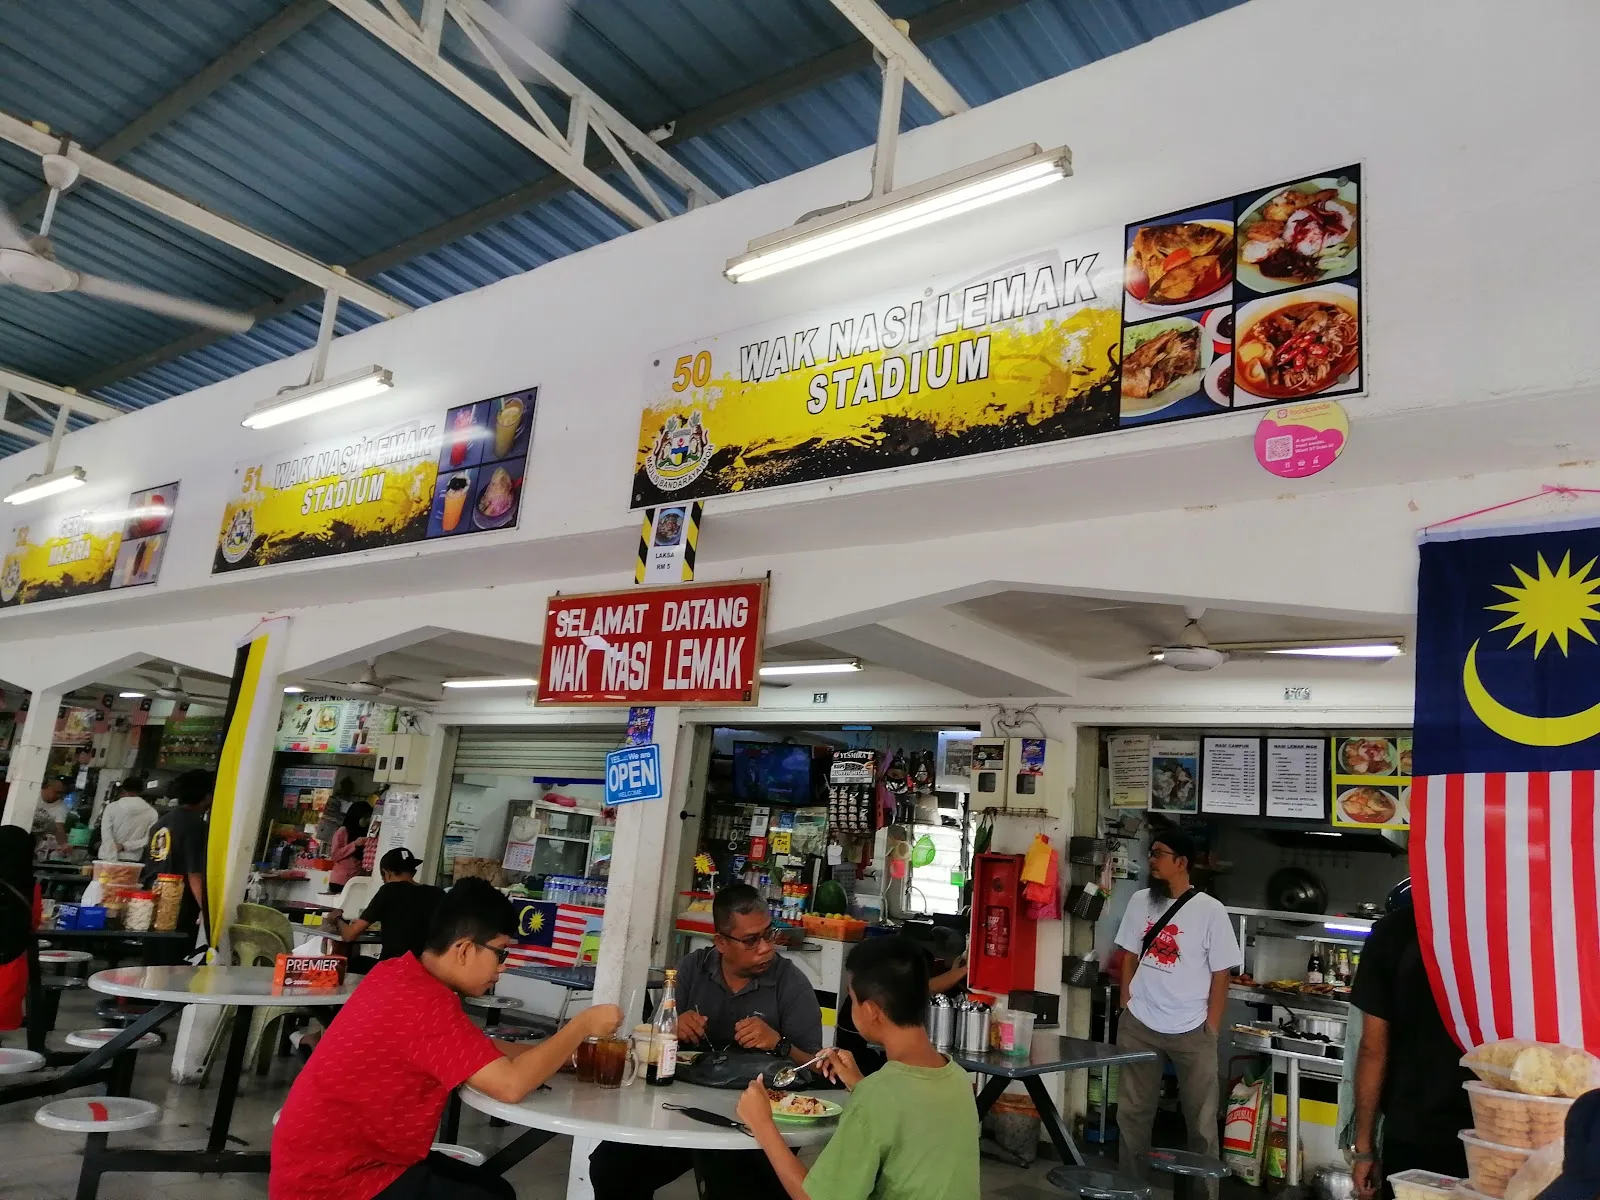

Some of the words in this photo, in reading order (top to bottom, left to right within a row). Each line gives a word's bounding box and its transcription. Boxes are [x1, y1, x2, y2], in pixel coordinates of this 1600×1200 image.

[739, 326, 819, 383] WAK
[827, 300, 922, 363] NASI
[935, 252, 1100, 336] LEMAK
[672, 351, 712, 392] 50
[806, 335, 991, 415] STADIUM
[273, 456, 314, 491] WAK
[314, 443, 361, 478] NASI
[362, 425, 435, 468] LEMAK
[659, 466, 701, 489] BANDARAYA
[242, 464, 262, 494] 51
[301, 472, 386, 516] STADIUM
[555, 603, 650, 637] SELAMAT
[661, 596, 749, 632] DATANG
[549, 645, 590, 692] WAK
[601, 641, 652, 691] NASI
[662, 636, 746, 691] LEMAK
[608, 758, 656, 793] OPEN
[618, 788, 643, 799] WELCOME
[285, 958, 338, 972] PREMIER
